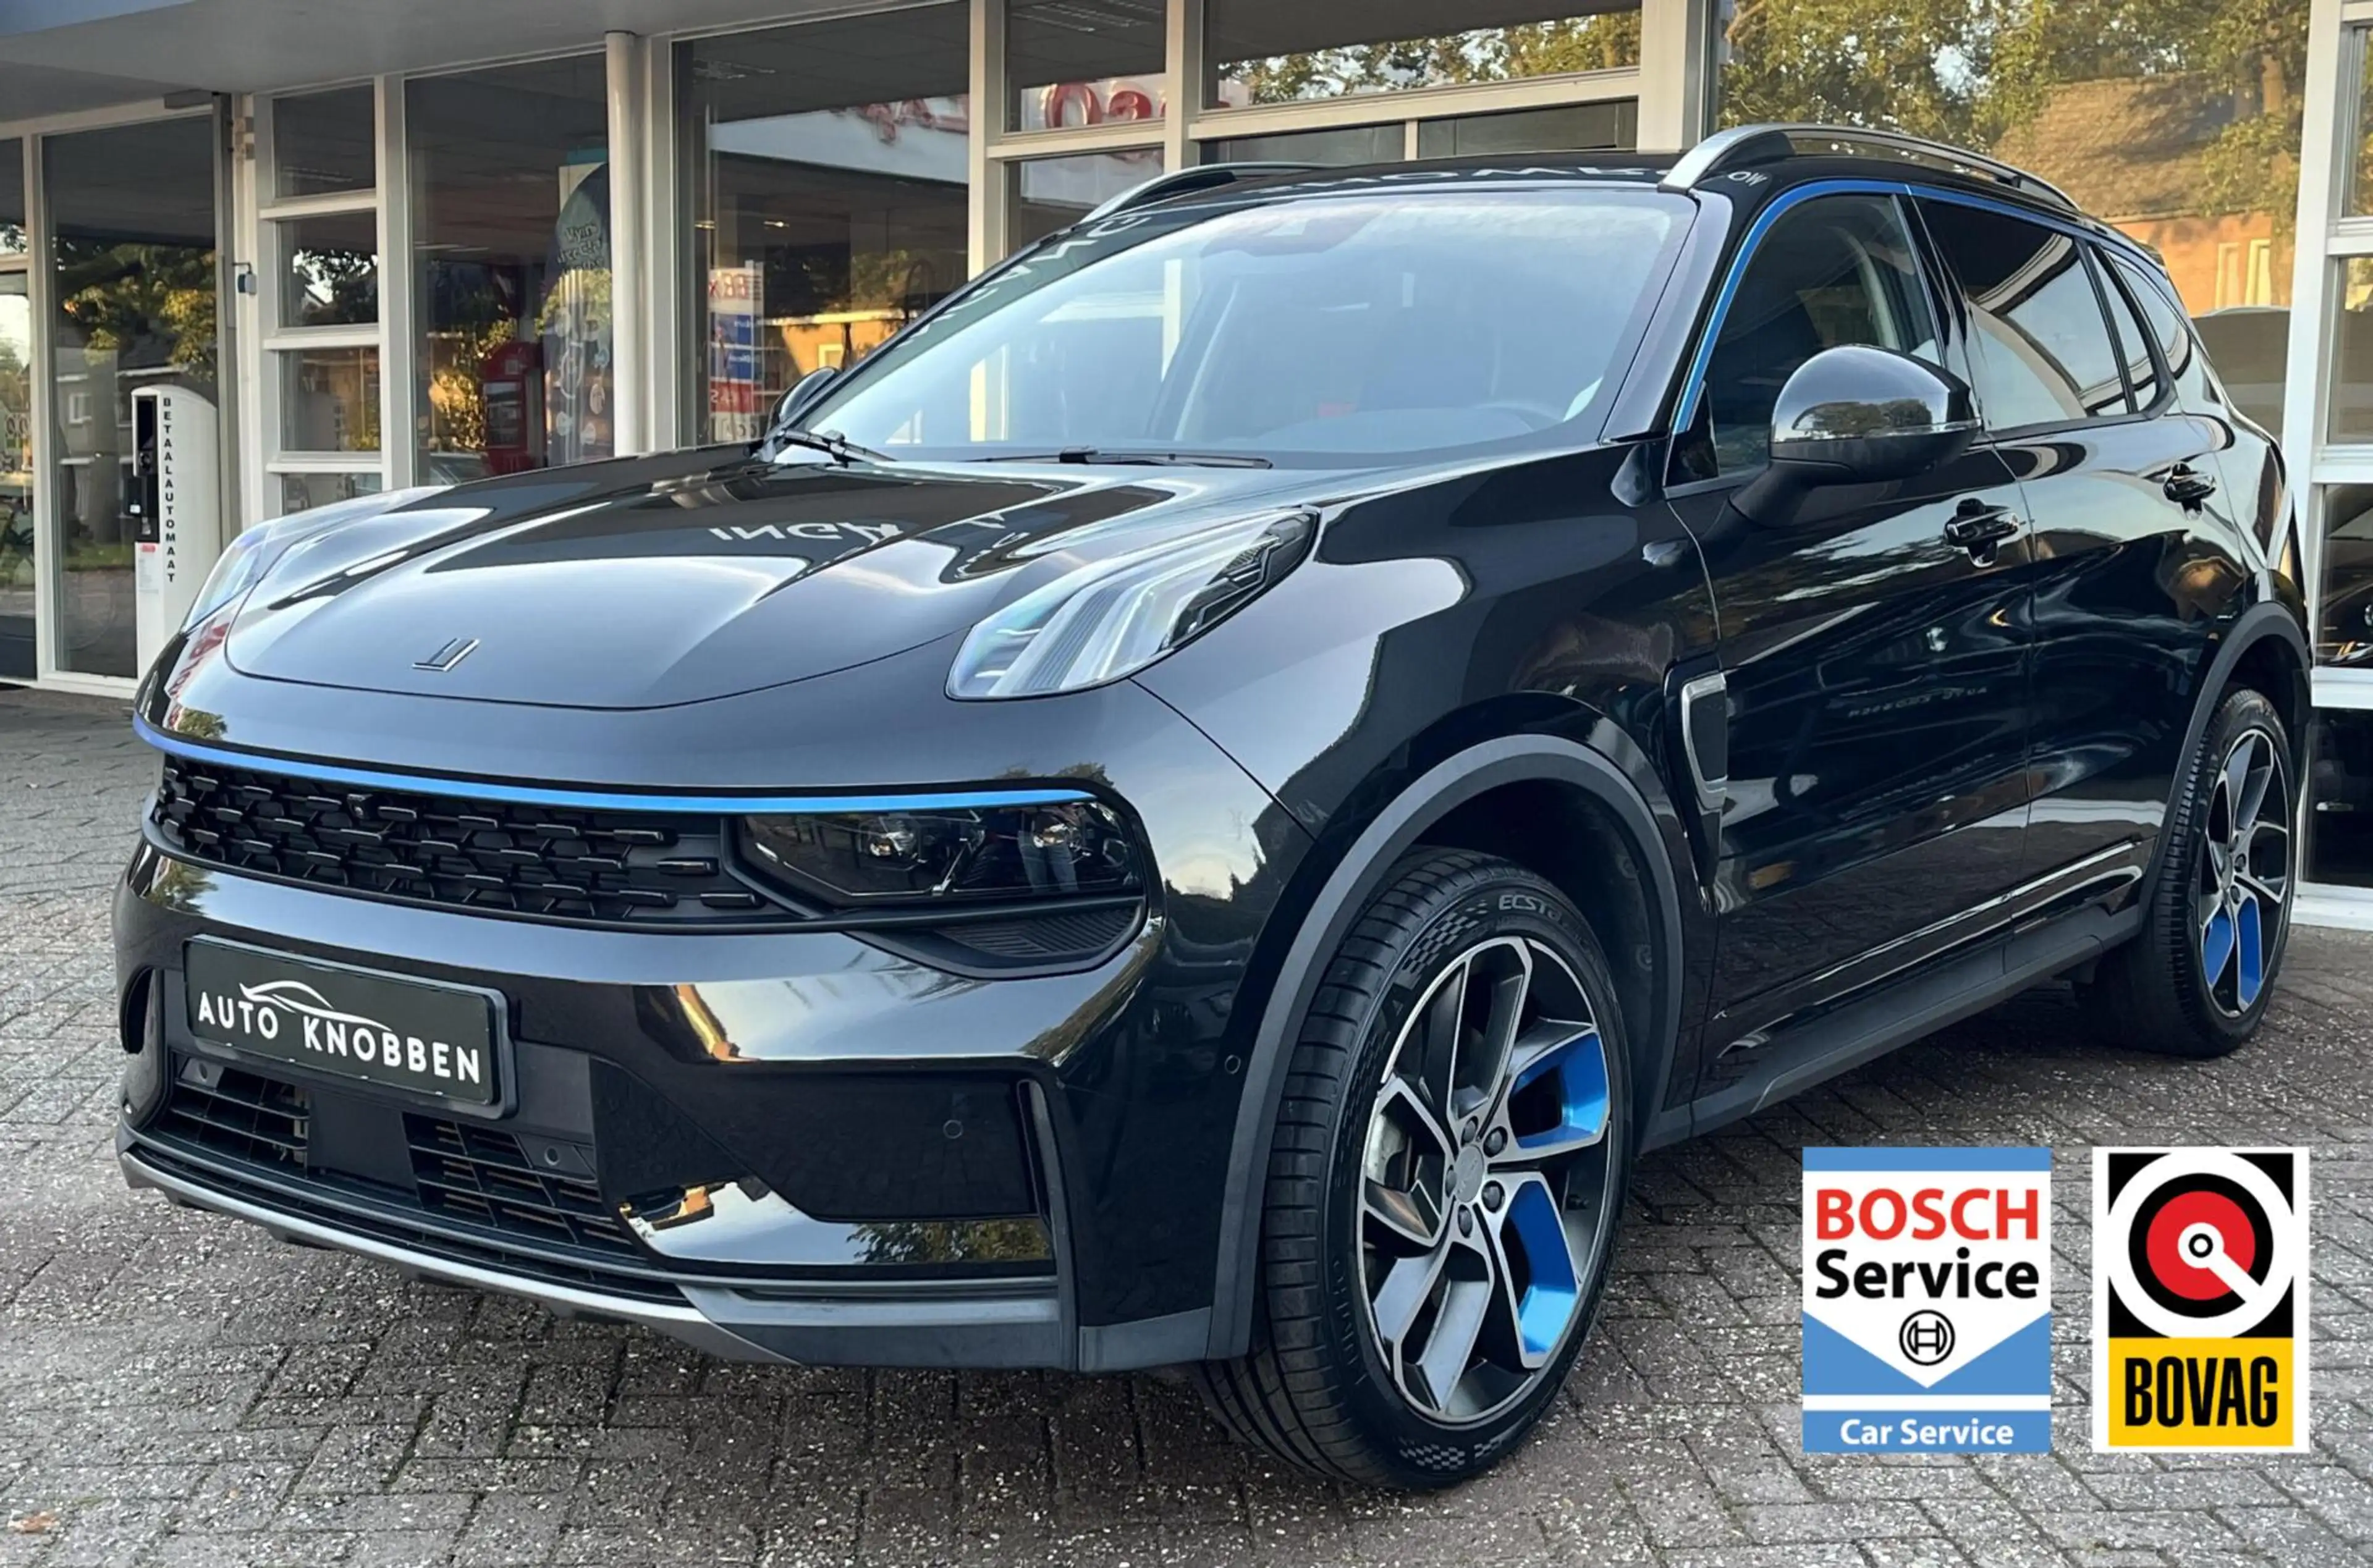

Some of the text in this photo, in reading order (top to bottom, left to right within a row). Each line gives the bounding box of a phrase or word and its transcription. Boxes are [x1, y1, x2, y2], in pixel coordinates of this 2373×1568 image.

[163, 397, 176, 583] BETAALAUTOMAAT
[198, 991, 480, 1084] AUTO KNOBBEN
